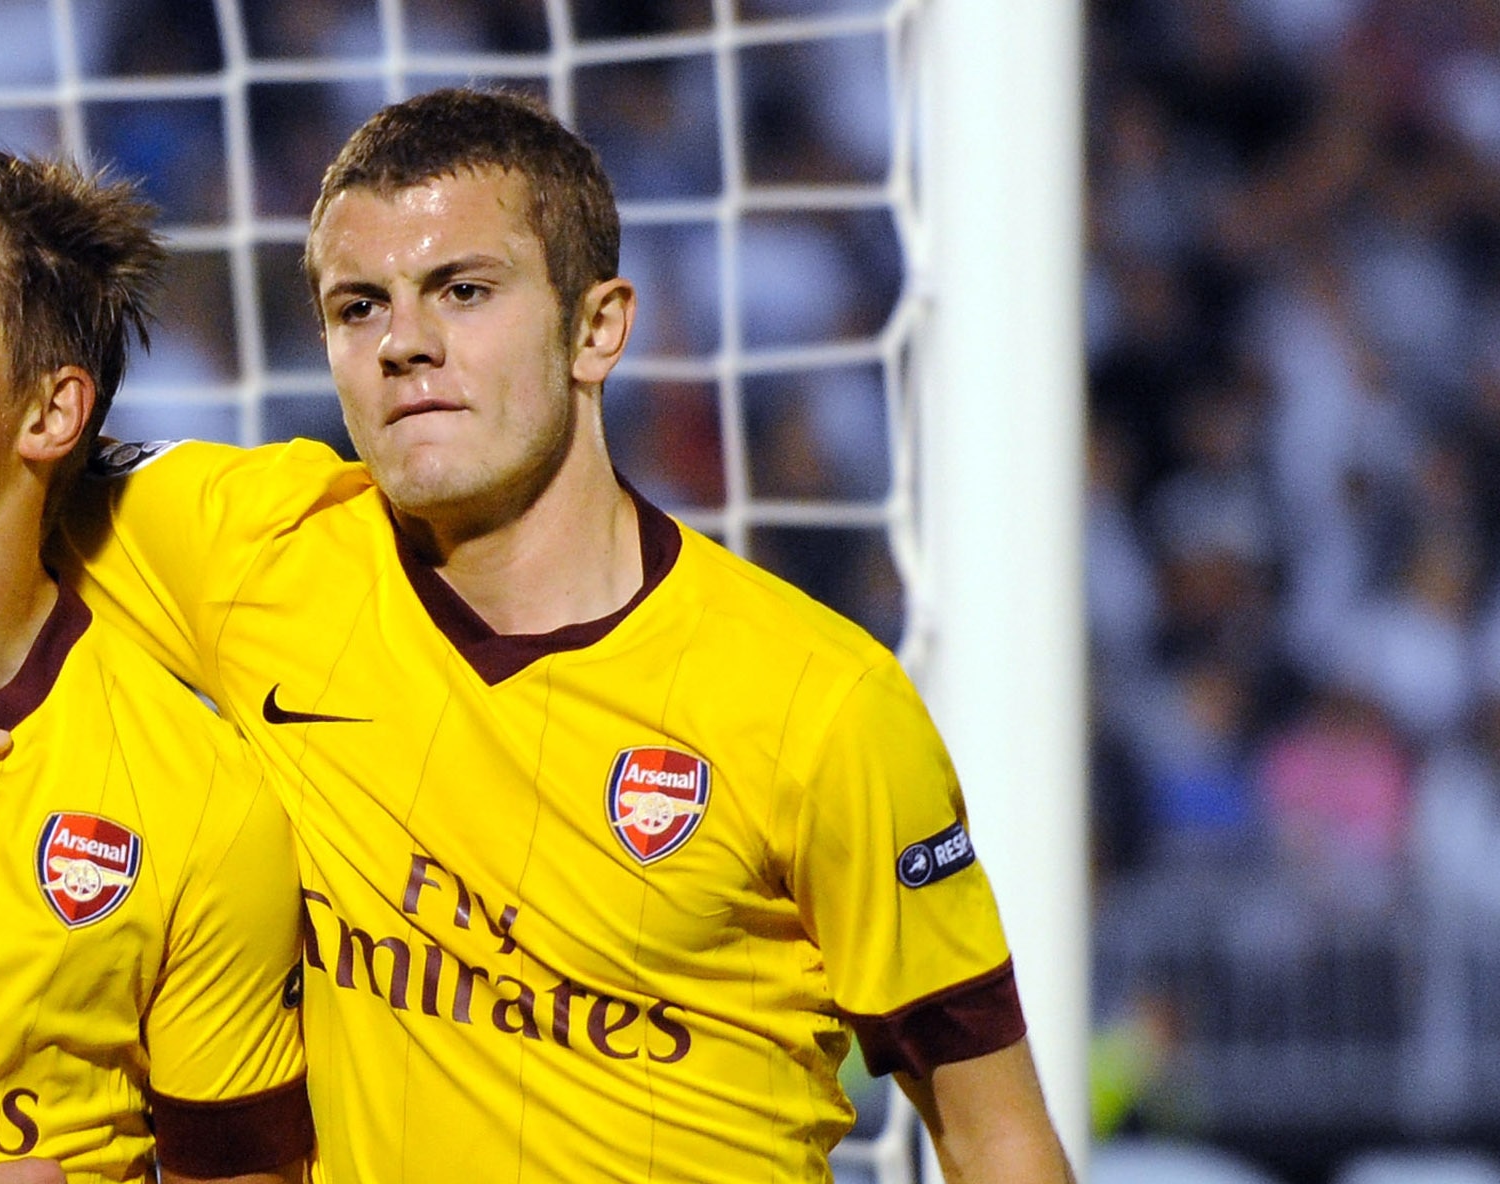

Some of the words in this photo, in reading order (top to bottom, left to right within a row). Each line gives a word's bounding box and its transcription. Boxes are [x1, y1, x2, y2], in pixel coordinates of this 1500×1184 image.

[624, 763, 695, 789] Arsenal
[54, 828, 127, 864] Arsenal
[402, 853, 518, 954] Fly
